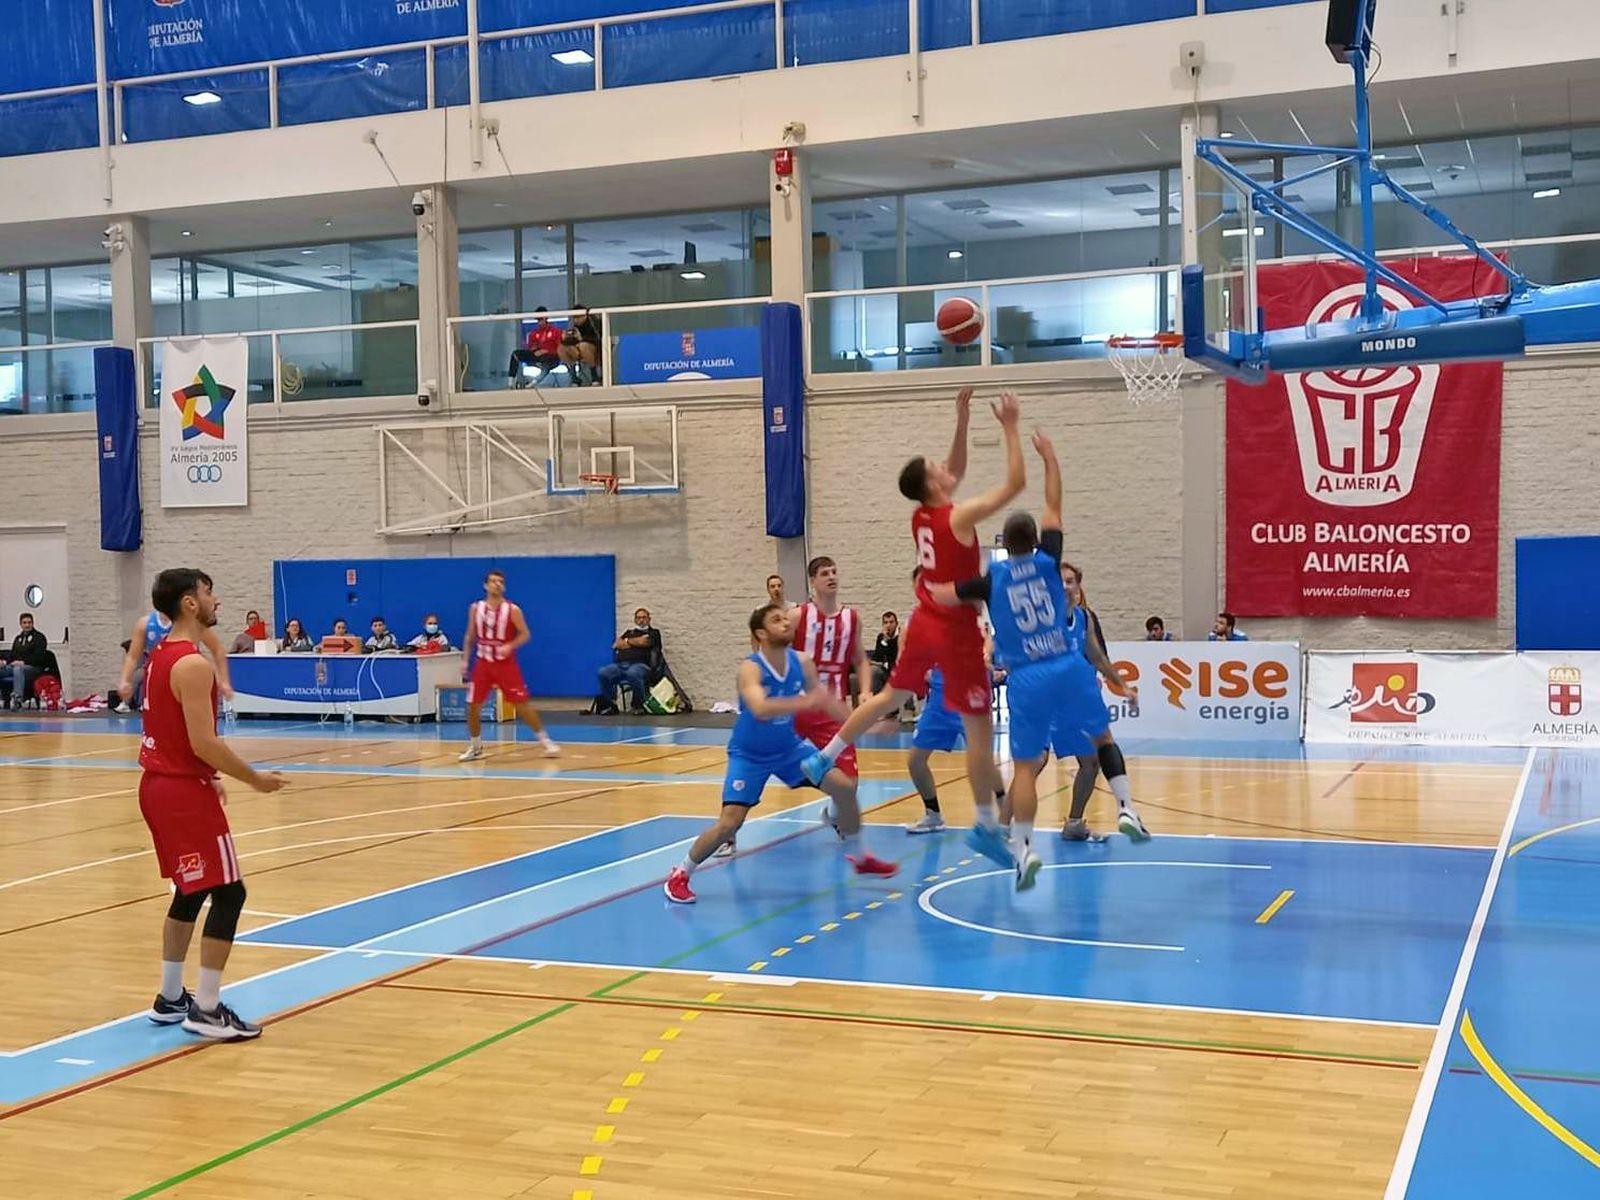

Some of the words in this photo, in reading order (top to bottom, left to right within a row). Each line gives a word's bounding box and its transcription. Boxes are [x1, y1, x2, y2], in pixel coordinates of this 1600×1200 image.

[396, 2, 412, 15] DE
[162, 31, 204, 46] ALMERÍA
[1361, 337, 1417, 352] MONDO
[643, 360, 689, 371] DIPUTACIÓN
[690, 360, 700, 369] DE
[701, 357, 735, 368] ALMERÍA
[212, 450, 238, 462] 2005
[1315, 475, 1401, 492] ALMERIA
[1251, 522, 1307, 544] CLUB
[1314, 522, 1471, 544] BALONCESTO
[1303, 549, 1410, 573] ALMERÍA
[1302, 584, 1410, 598] www.cbalmeria.es
[1006, 576, 1056, 634] 55
[1199, 661, 1289, 699] ise
[1199, 702, 1289, 724] energía
[1532, 721, 1599, 735] ALMERÍA
